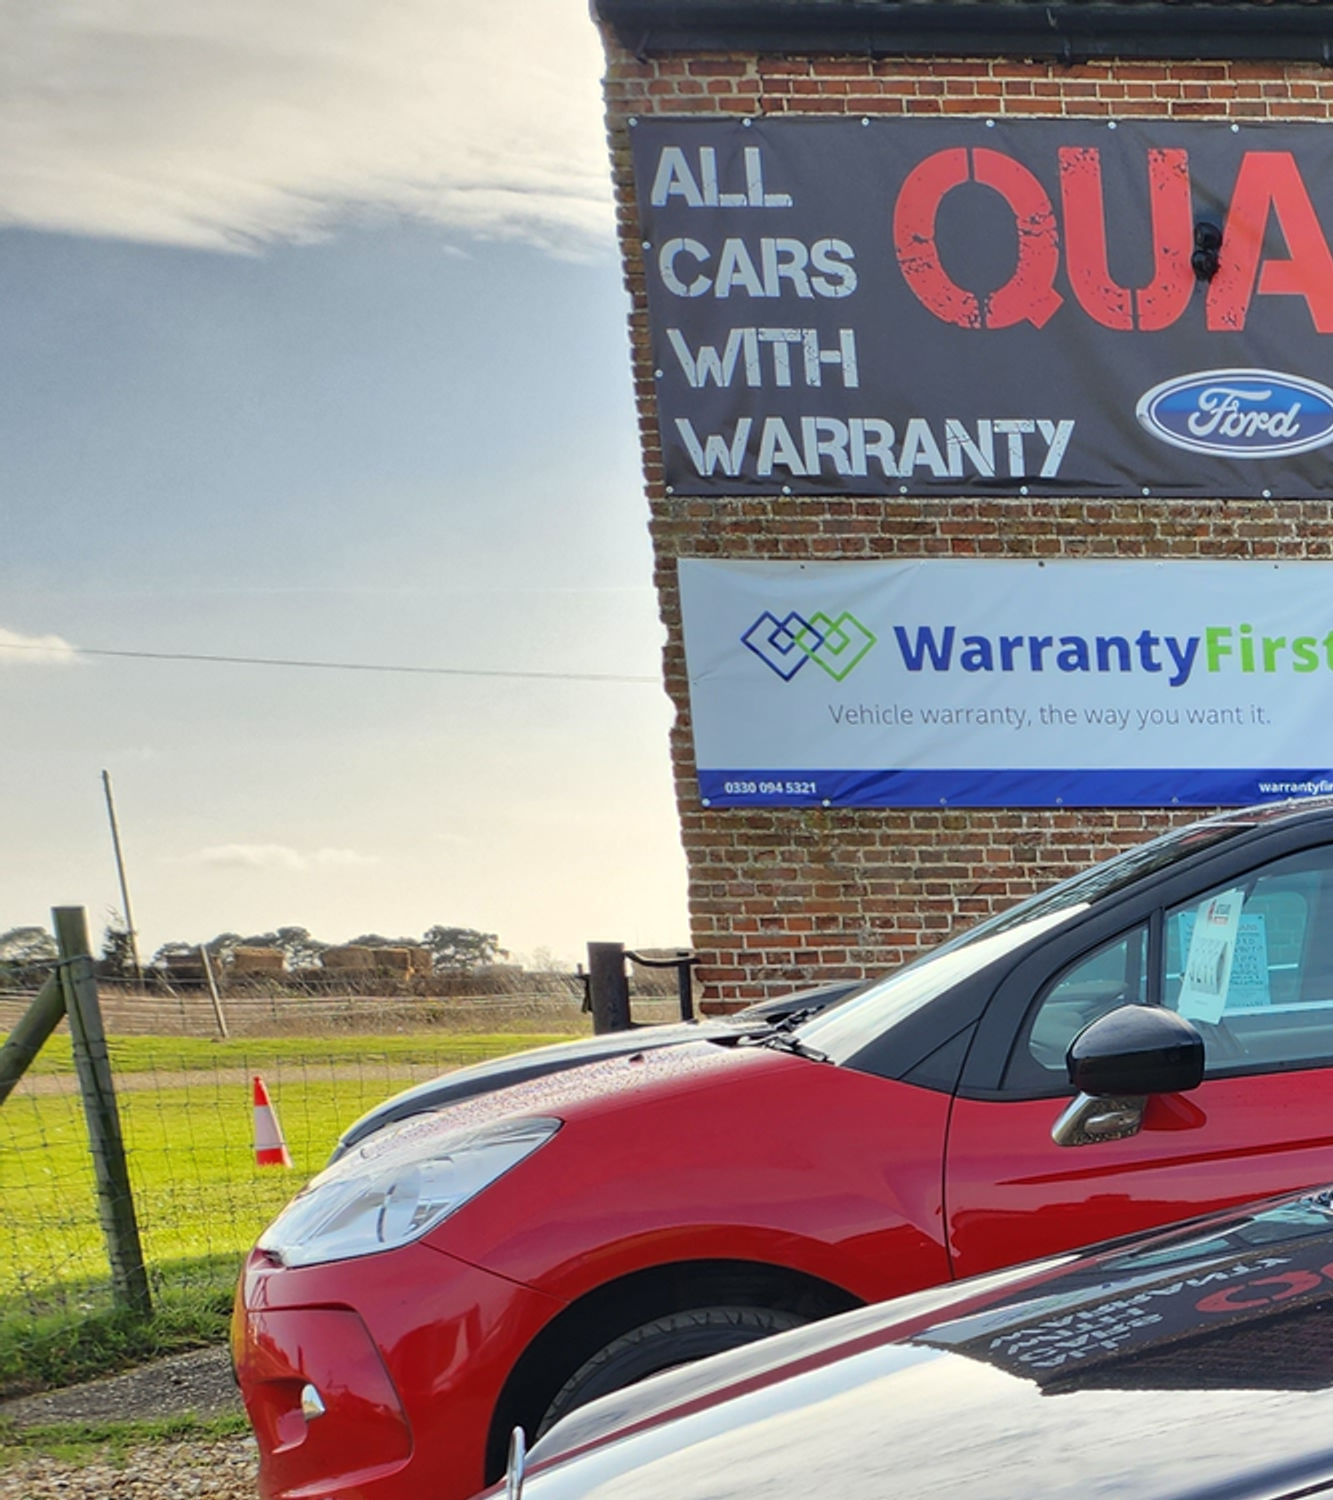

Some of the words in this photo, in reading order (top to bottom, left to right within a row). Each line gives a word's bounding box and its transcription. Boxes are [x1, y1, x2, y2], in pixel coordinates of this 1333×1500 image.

[651, 146, 793, 208] ALL
[659, 238, 858, 299] CARS
[667, 328, 859, 389] WITH
[1189, 388, 1300, 440] Ford
[676, 416, 1075, 479] WARRANTY
[829, 703, 913, 728] Vehicle
[921, 705, 1033, 732] warranty,
[1039, 703, 1078, 727] the
[1084, 708, 1131, 732] way
[1137, 708, 1181, 732] you
[1186, 705, 1244, 727] want
[1249, 703, 1272, 726] it.
[724, 781, 757, 795] 0330
[759, 781, 784, 795] 094
[786, 781, 817, 795] 5321
